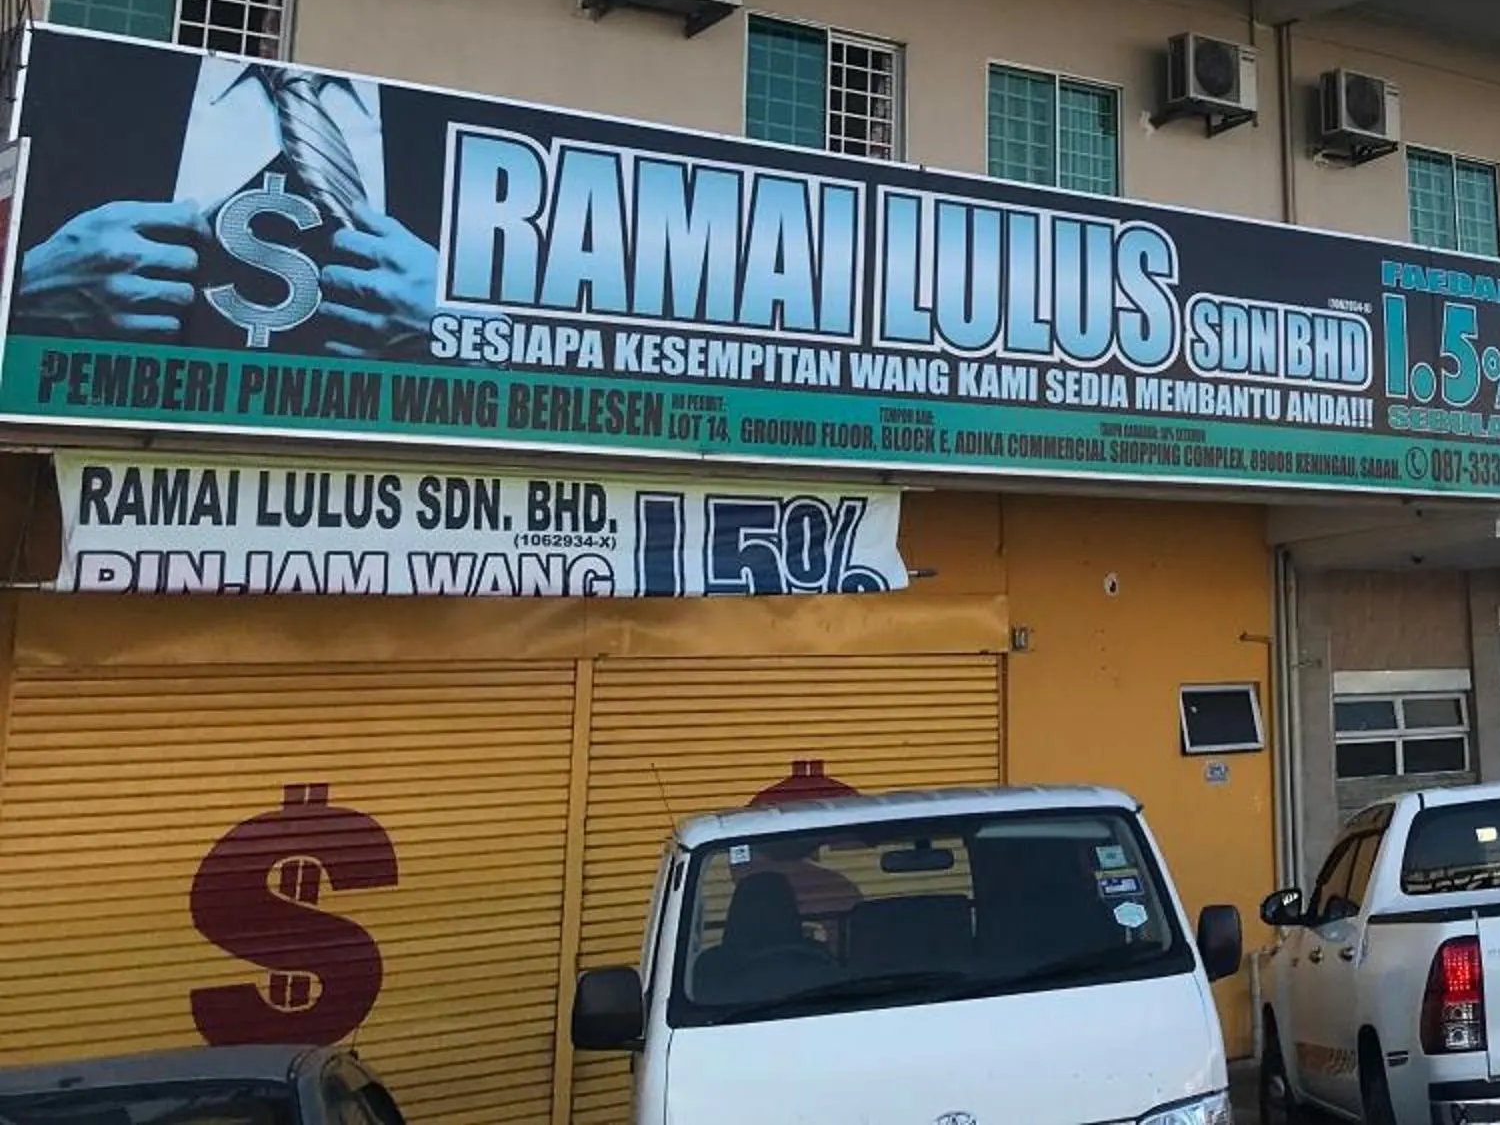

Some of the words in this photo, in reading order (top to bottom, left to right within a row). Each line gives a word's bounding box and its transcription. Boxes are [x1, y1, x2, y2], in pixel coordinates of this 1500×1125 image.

[437, 122, 866, 345] RAMAI
[872, 184, 1179, 373] LULUS
[1186, 293, 1281, 378] SDN
[1282, 303, 1374, 391] BHD
[38, 349, 229, 413] PEMBERI
[237, 364, 383, 421] PINJAM
[391, 374, 499, 428] WANG
[507, 382, 664, 437] BERLESEN
[429, 314, 603, 370] SESIAPA
[614, 332, 840, 388] KESEMPITAN
[849, 353, 949, 397] WANG
[957, 364, 1037, 402] KAMI
[1045, 372, 1128, 411] SEDIA
[1134, 378, 1281, 422] MEMBANTU
[1286, 391, 1374, 428] ANDA!!!
[668, 413, 703, 441] LOT
[740, 417, 817, 447] GROUND
[881, 425, 936, 453] BLOCK
[954, 430, 1005, 457] ADIKA
[1008, 432, 1107, 462] COMMERCIAL
[1110, 439, 1180, 466] SHOPPING
[79, 466, 241, 527] RAMAI
[256, 470, 403, 530] LULUS
[416, 475, 512, 531] SDN.
[528, 480, 618, 534] BHD.
[513, 533, 617, 551] (1062934-X)
